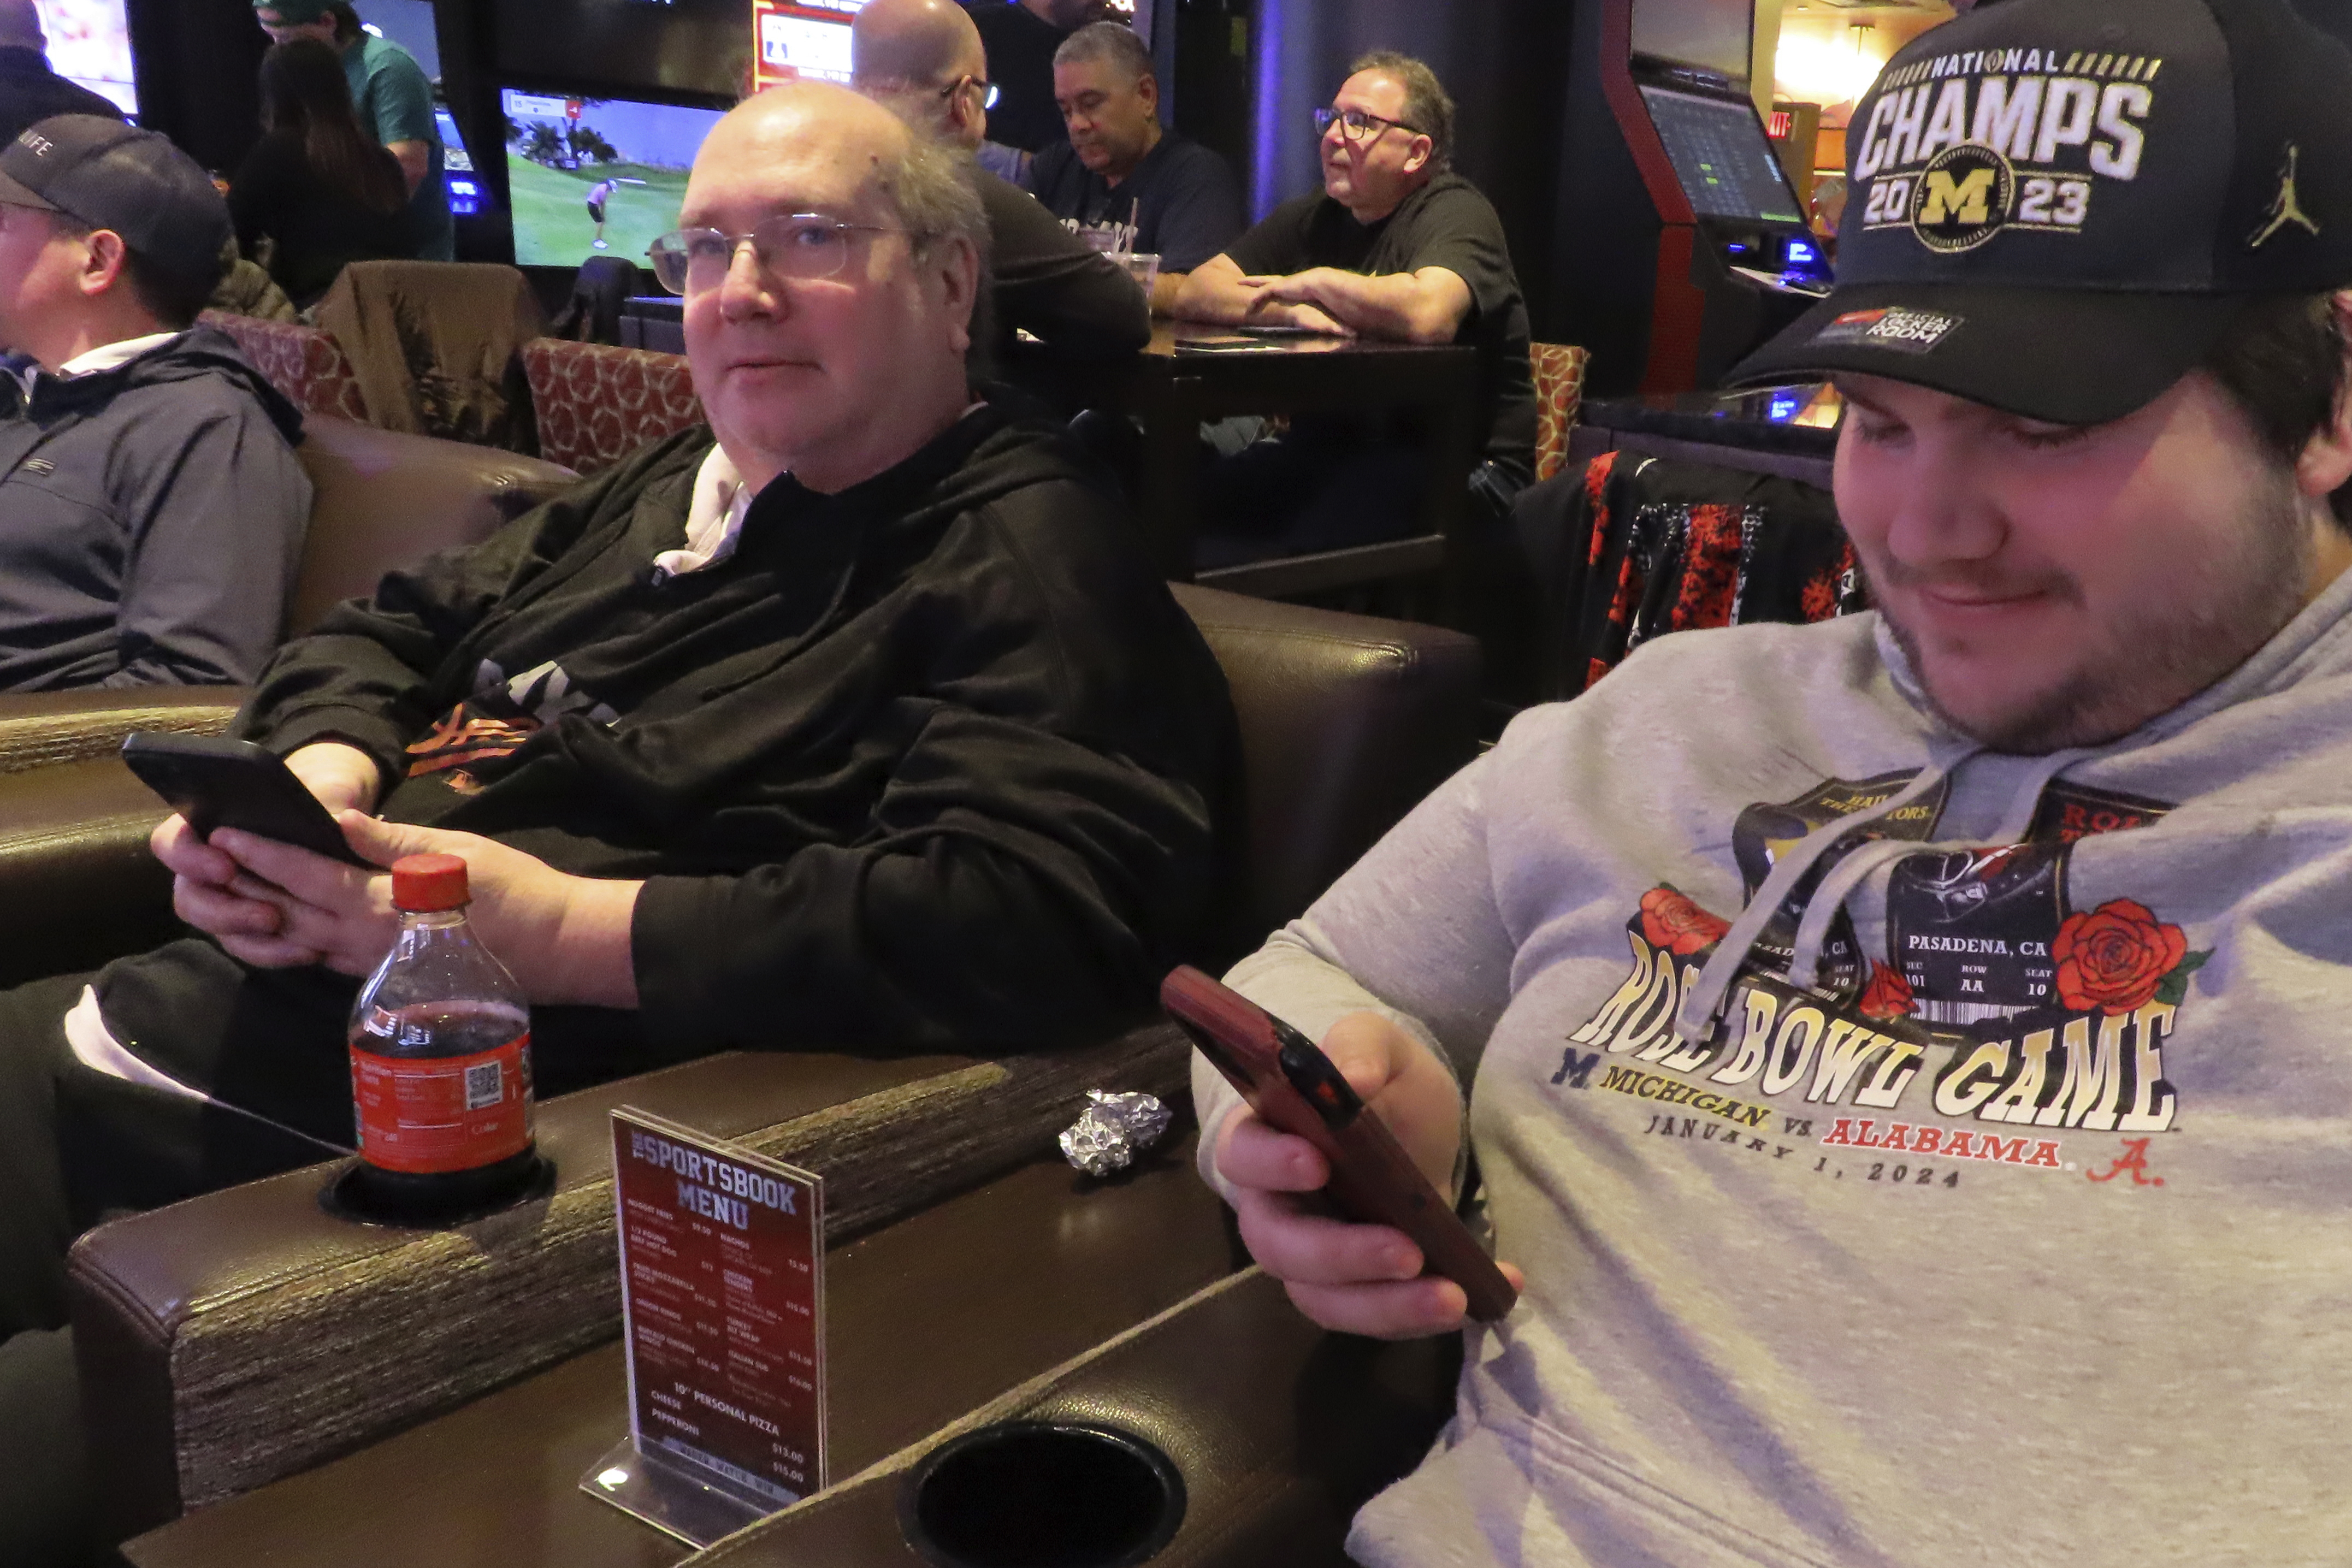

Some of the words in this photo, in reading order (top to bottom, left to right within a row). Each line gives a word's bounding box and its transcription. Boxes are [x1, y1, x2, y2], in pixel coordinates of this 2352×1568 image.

[1931, 47, 2059, 79] NATIONAL
[1767, 111, 1790, 138] XIT
[1854, 74, 2154, 181] CHAMPS
[1863, 180, 1911, 223] 20
[1918, 167, 1996, 225] M
[2018, 177, 2091, 225] 23
[1866, 324, 1939, 345] ROOM
[1877, 317, 1948, 334] LOCKER
[1908, 934, 2014, 957] PASADENA,
[2019, 941, 2047, 956] CA
[1833, 977, 1850, 987] 10
[1960, 964, 1988, 974] ROW
[2025, 968, 2053, 978] SEAT
[1960, 978, 1984, 993] AA
[2028, 983, 2047, 996] 10
[1711, 989, 1923, 1108] BOWL
[1935, 1003, 2177, 1132] GAME
[1550, 1048, 1601, 1089] M
[1599, 1066, 1772, 1128] MICHIGAN
[1821, 1119, 2060, 1168] ALABAMA
[1644, 1115, 1794, 1160] JANUARY
[1813, 1157, 1844, 1180] 1,
[1867, 1162, 1960, 1188] 2024
[643, 1134, 797, 1216] SPORTSBOOK
[676, 1180, 749, 1231] MENU
[651, 1389, 682, 1411] CHEESE
[694, 1390, 747, 1423] PERSONAL
[748, 1413, 780, 1437] PIZZA
[651, 1407, 700, 1436] PEPPERONI
